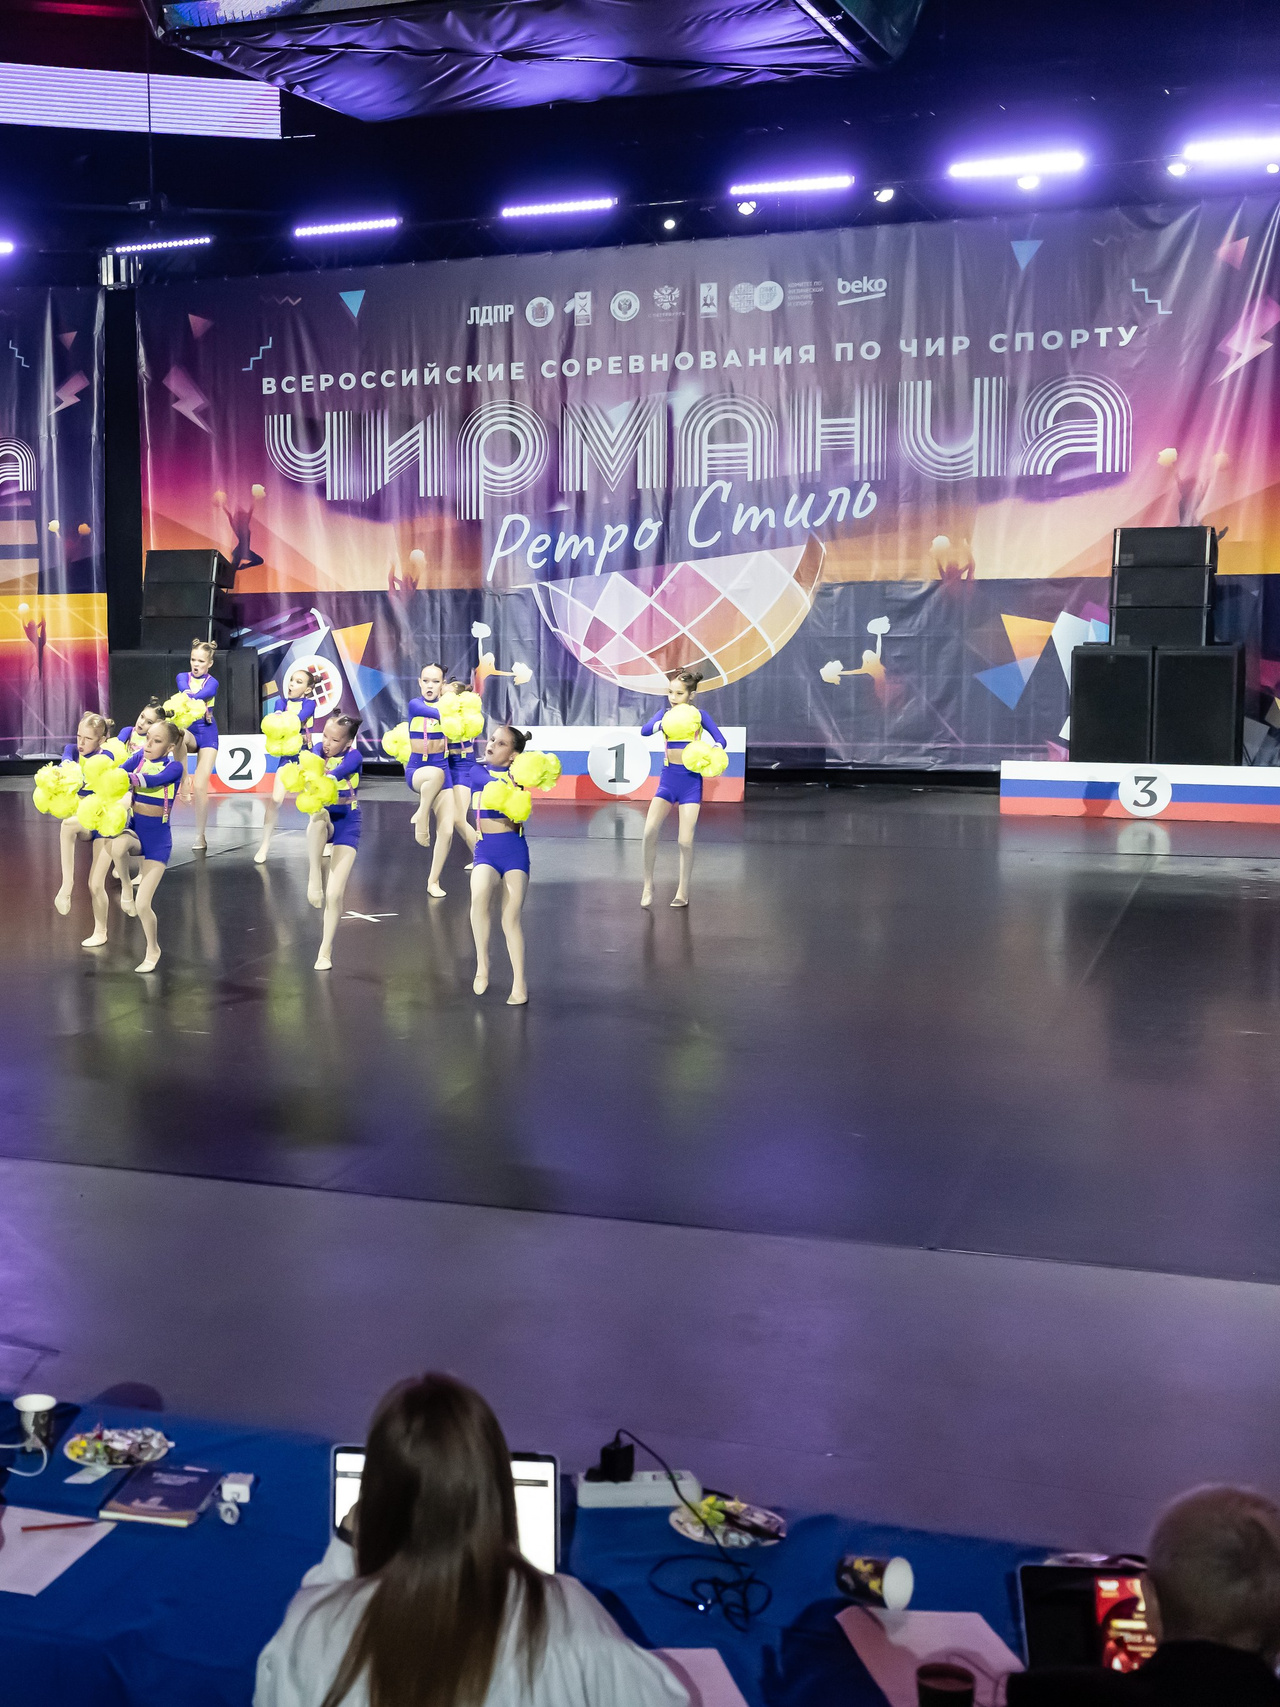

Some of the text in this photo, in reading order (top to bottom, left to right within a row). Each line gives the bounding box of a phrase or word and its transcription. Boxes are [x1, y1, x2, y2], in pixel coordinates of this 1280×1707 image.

[837, 276, 887, 294] beko
[467, 304, 514, 326] ЛДПР
[262, 325, 1139, 395] ВСЕРОССИЙСКИЕ СОРЕВНОВАНИЯ ПО ЧИР СПОРТУ
[486, 479, 878, 582] Ретро Стиль
[228, 747, 253, 781] 2
[607, 742, 631, 784] 1
[1133, 776, 1158, 807] 3
